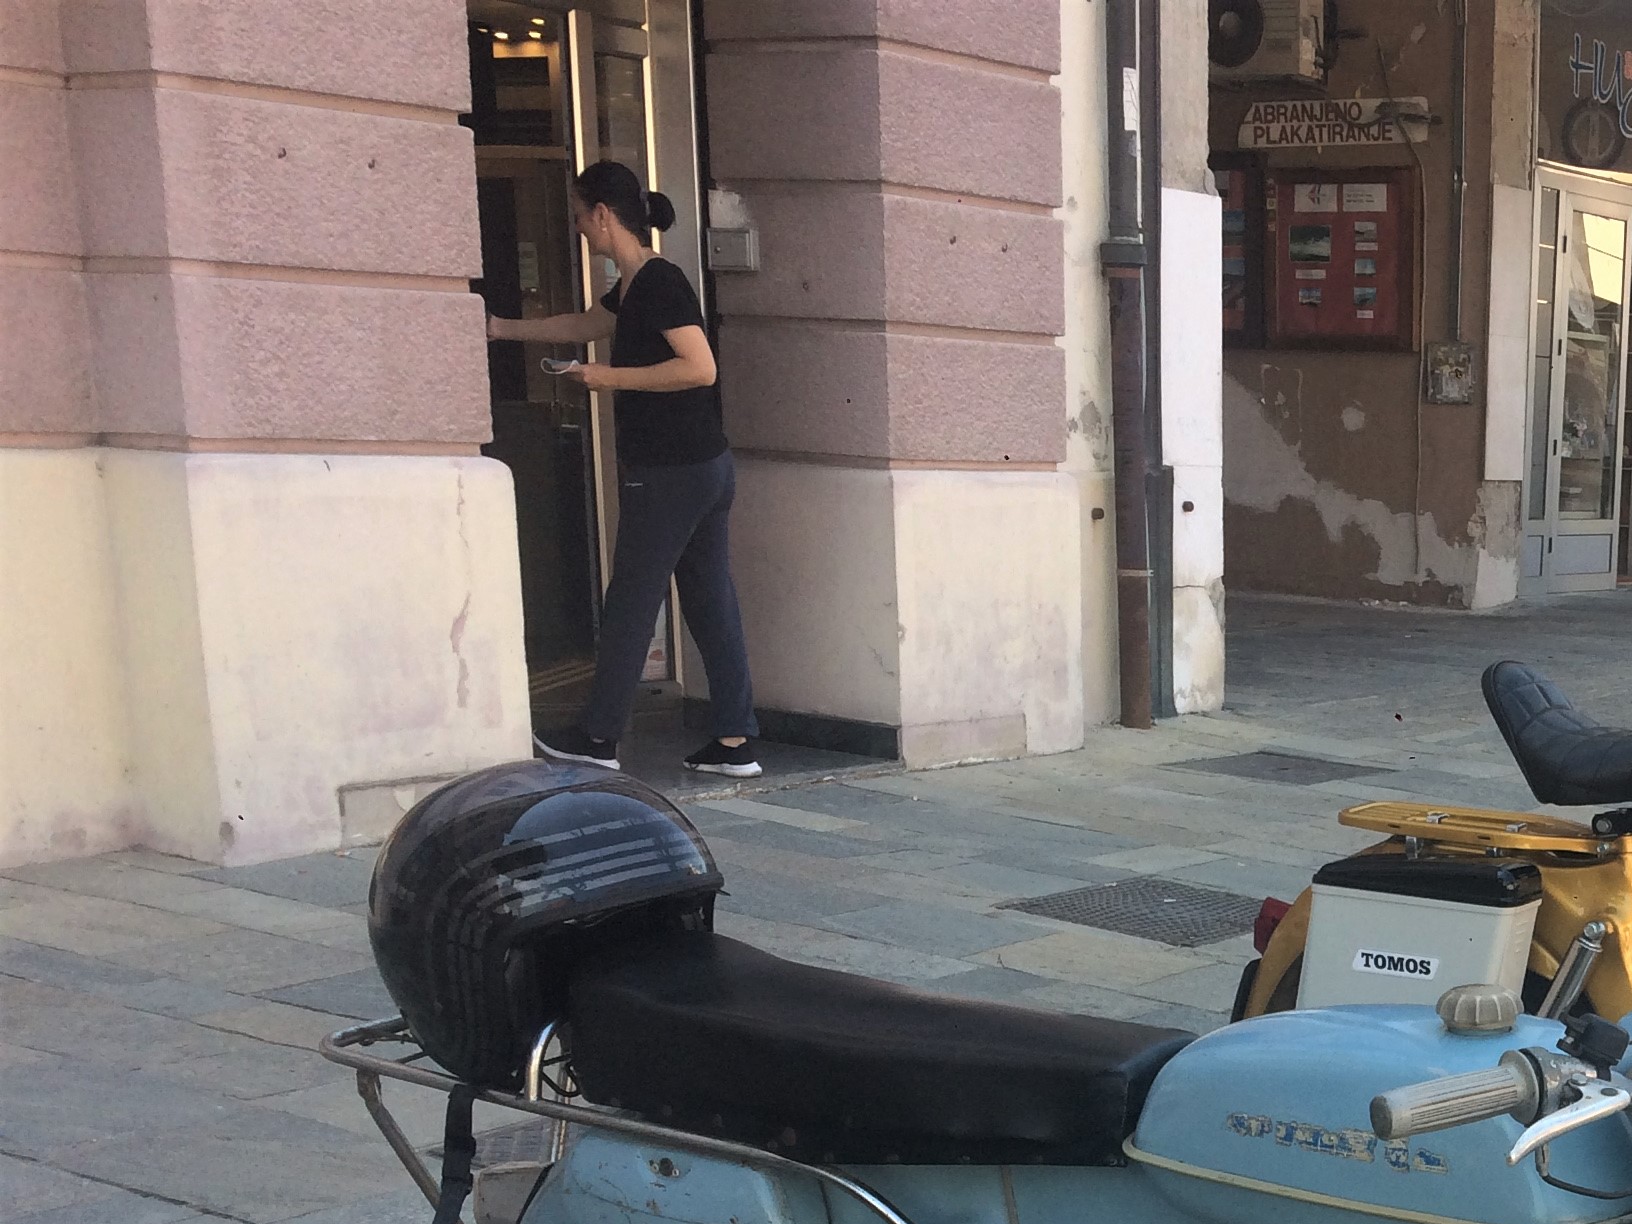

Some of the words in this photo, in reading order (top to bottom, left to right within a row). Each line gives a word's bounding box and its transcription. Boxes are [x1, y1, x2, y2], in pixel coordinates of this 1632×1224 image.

[1244, 102, 1363, 124] ABRANJENO
[1253, 121, 1393, 145] PLAKATIRANJE
[1361, 952, 1431, 976] TOMOS
